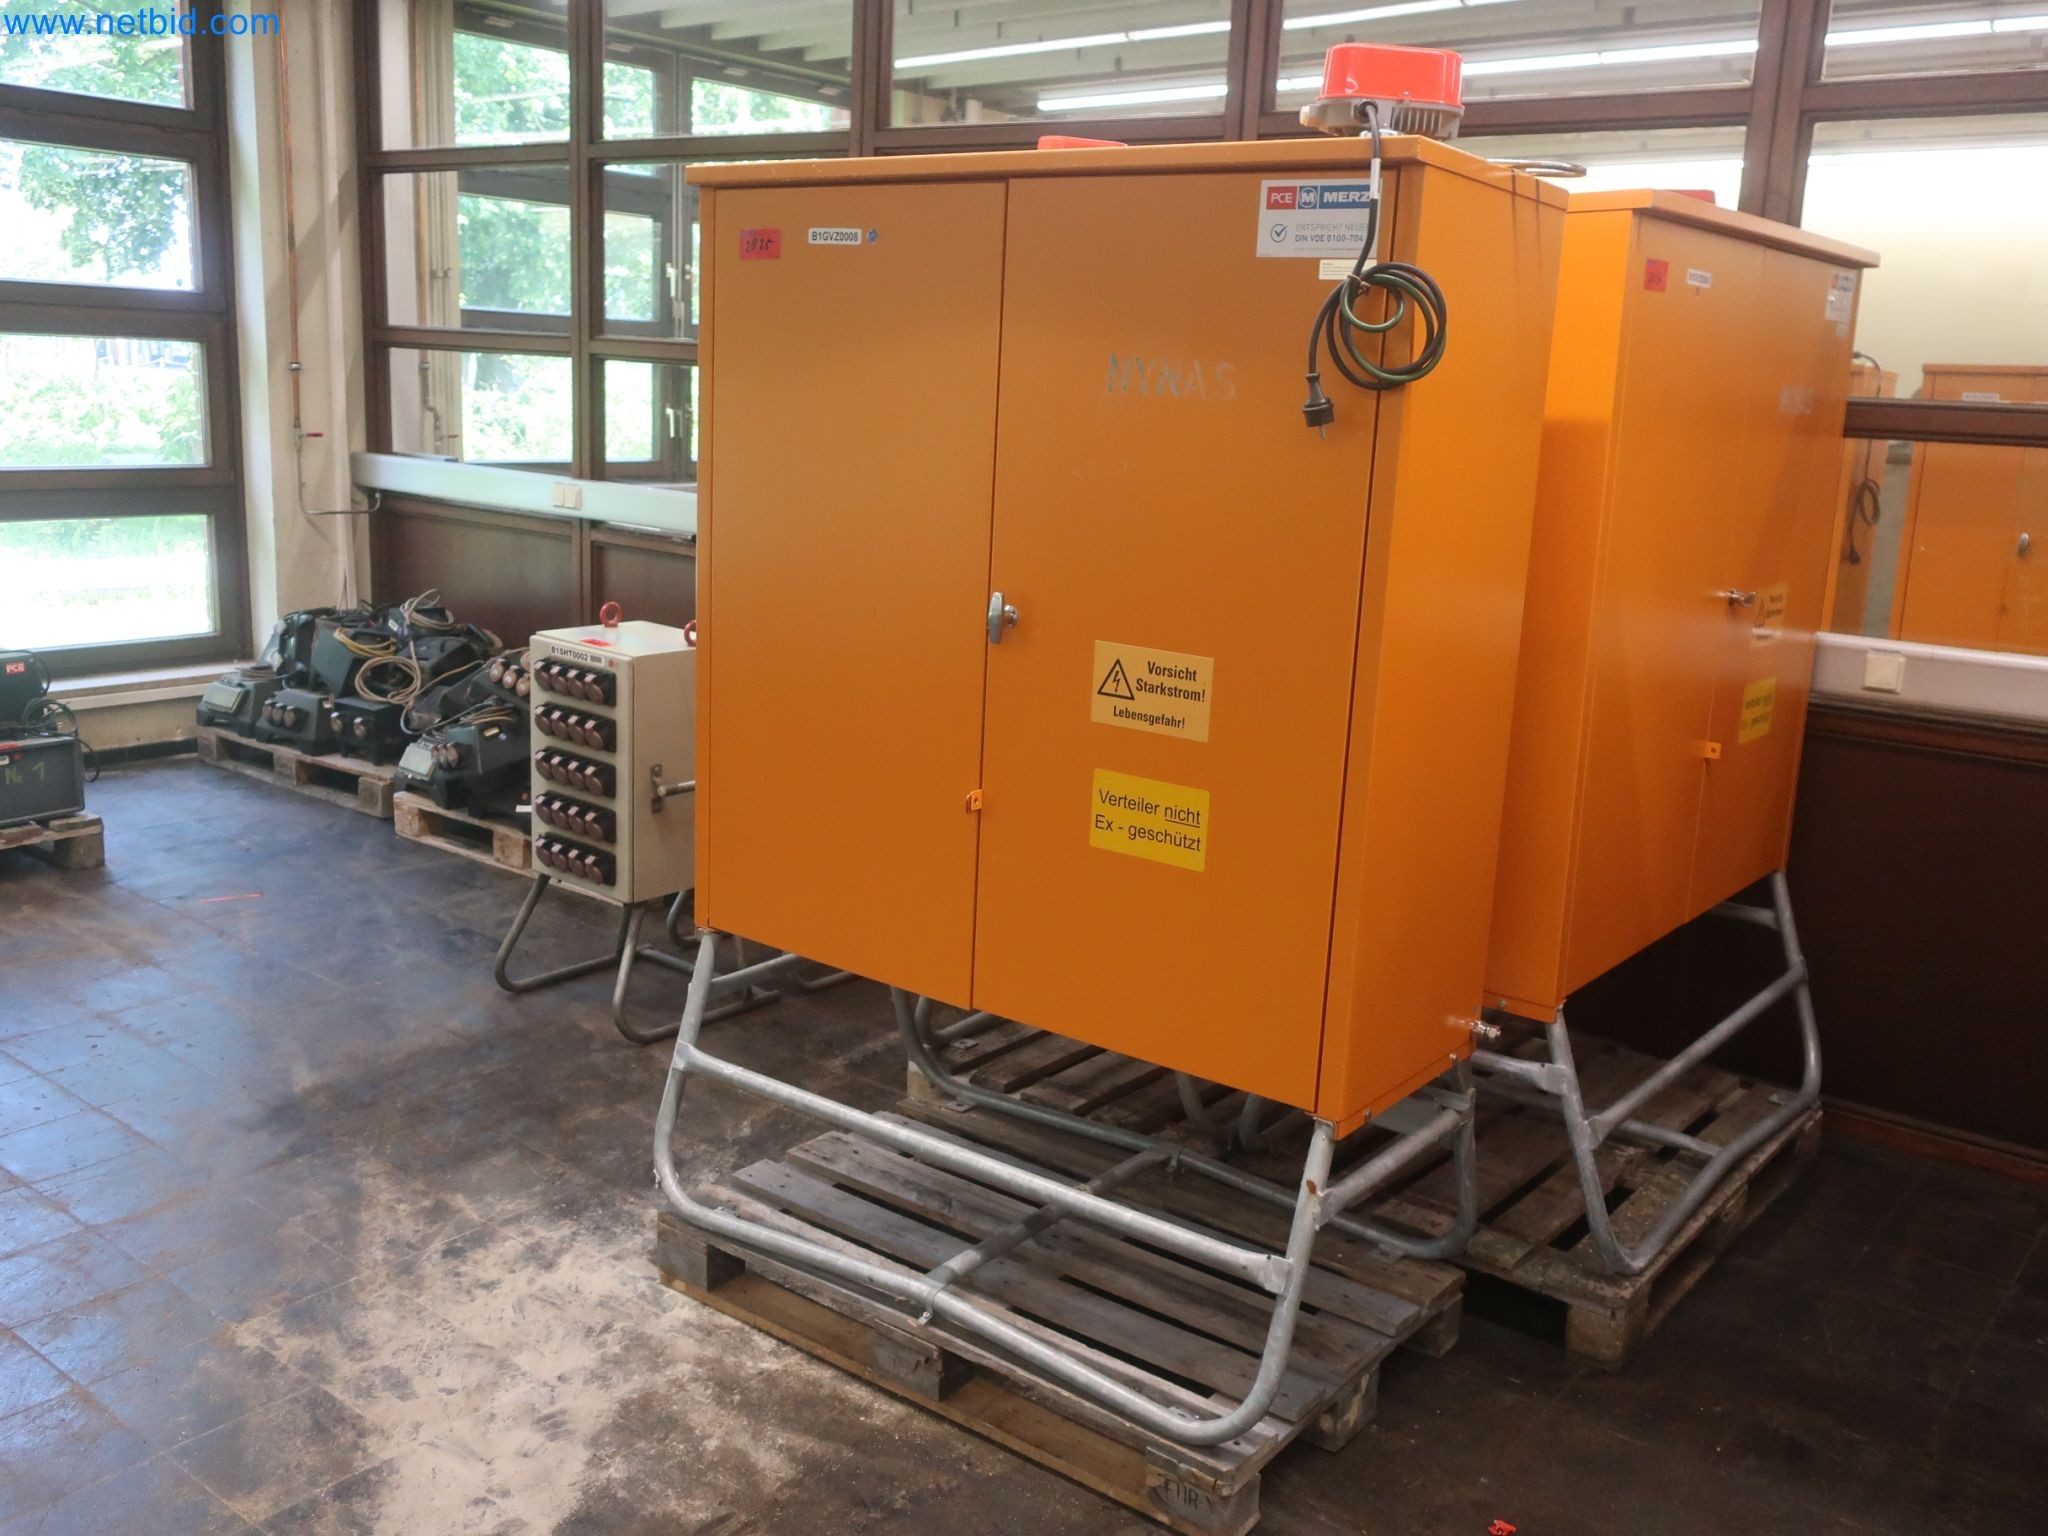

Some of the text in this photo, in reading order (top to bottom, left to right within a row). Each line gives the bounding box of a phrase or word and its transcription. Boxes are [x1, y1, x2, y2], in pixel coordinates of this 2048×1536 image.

[1270, 192, 1293, 204] PCE
[1323, 191, 1371, 203] MERZ
[811, 231, 859, 242] B1GVZ0008
[1295, 223, 1343, 232] ENTSPRICHT
[1295, 233, 1364, 242] DIN VDE 0100-704
[6, 661, 25, 674] PCE
[1147, 660, 1198, 683] Vorsicht
[1136, 678, 1206, 702] Starkstrom!
[1113, 704, 1186, 729] Lebensgefahr!
[1098, 788, 1201, 826] Verteiler nicht
[1094, 814, 1113, 831] Ex
[1127, 822, 1202, 852] geschützt
